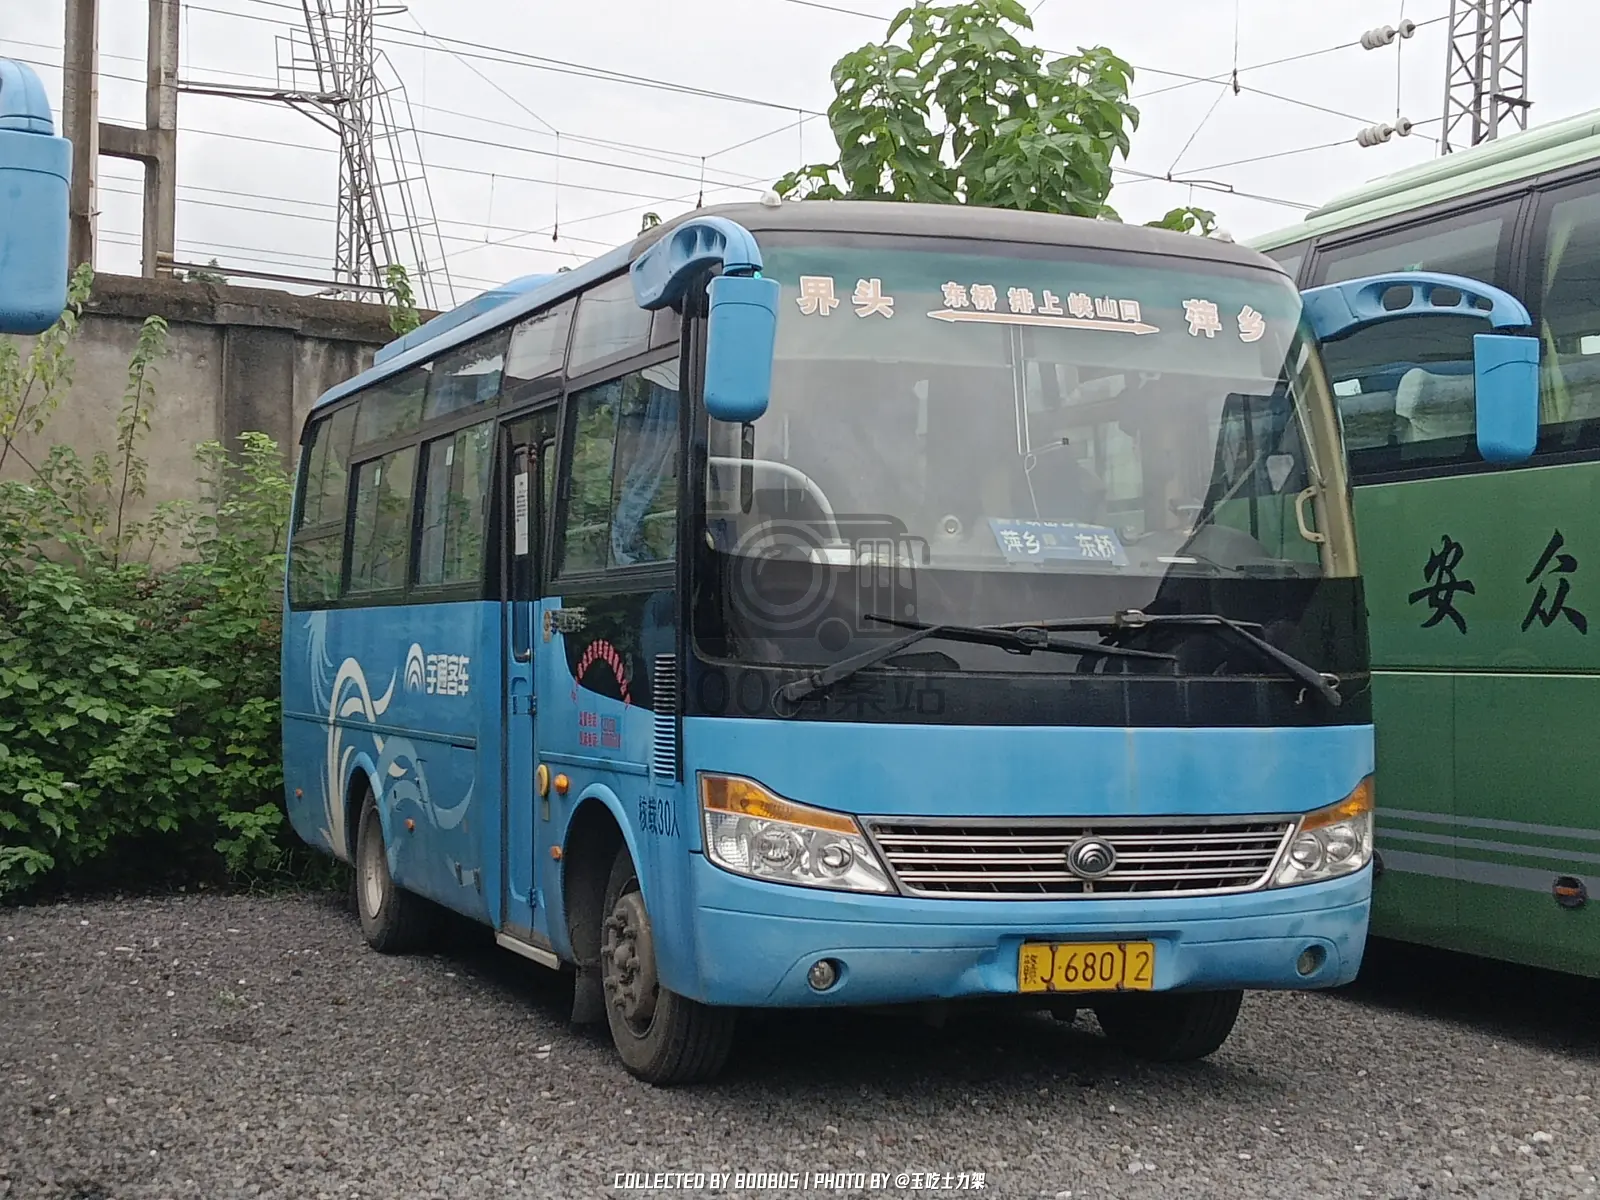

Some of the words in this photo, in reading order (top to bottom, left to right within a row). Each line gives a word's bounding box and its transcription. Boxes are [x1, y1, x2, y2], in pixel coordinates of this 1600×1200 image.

[796, 275, 895, 319] 界头
[941, 281, 997, 311] 东桥
[1007, 287, 1063, 315] 排上
[1182, 298, 1266, 343] 萍乡
[1000, 529, 1041, 554] 萍乡
[1075, 533, 1117, 558] 东桥
[426, 653, 470, 698] 宇通客车
